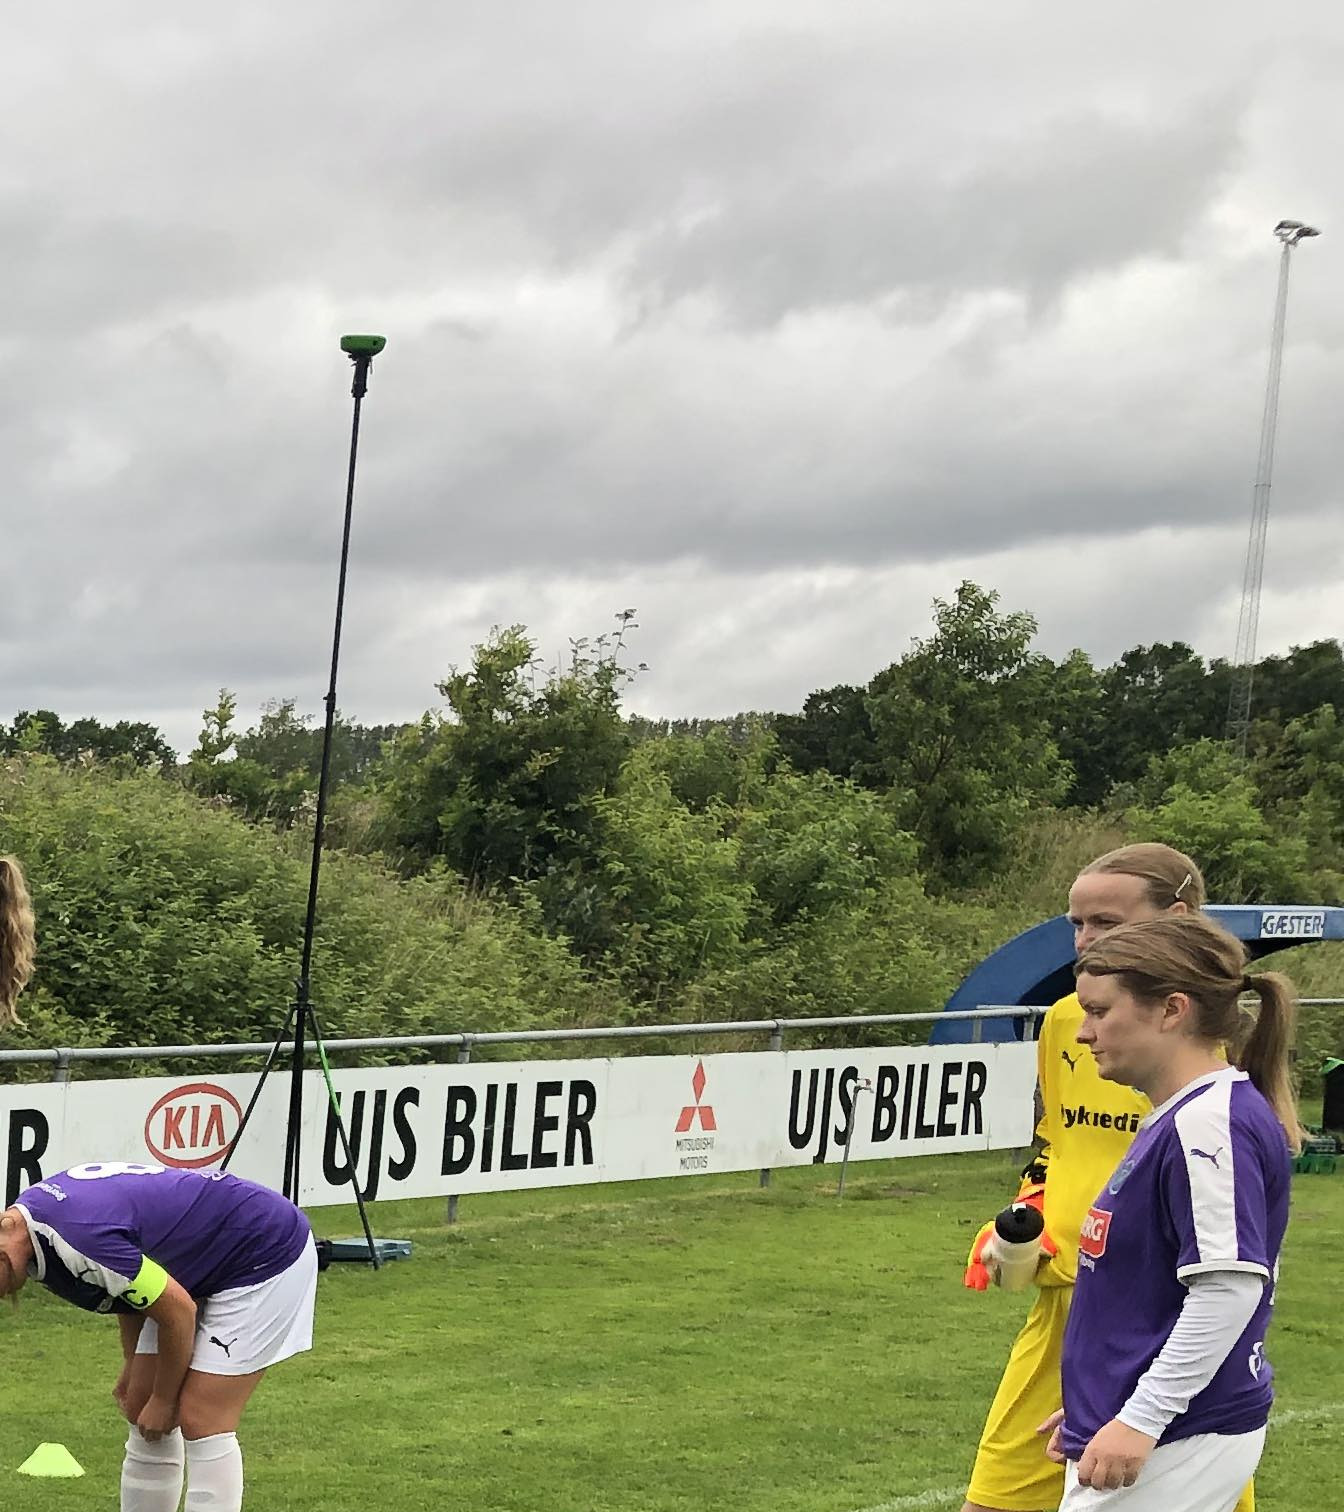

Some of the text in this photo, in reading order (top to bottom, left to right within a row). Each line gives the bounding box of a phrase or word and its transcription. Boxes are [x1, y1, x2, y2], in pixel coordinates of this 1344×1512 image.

[1265, 914, 1322, 935] GÆSTER
[163, 1104, 226, 1149] KIA
[788, 1060, 987, 1165] UJS BILER
[322, 1079, 597, 1202] UJS BILER
[679, 1155, 709, 1171] MOTORS
